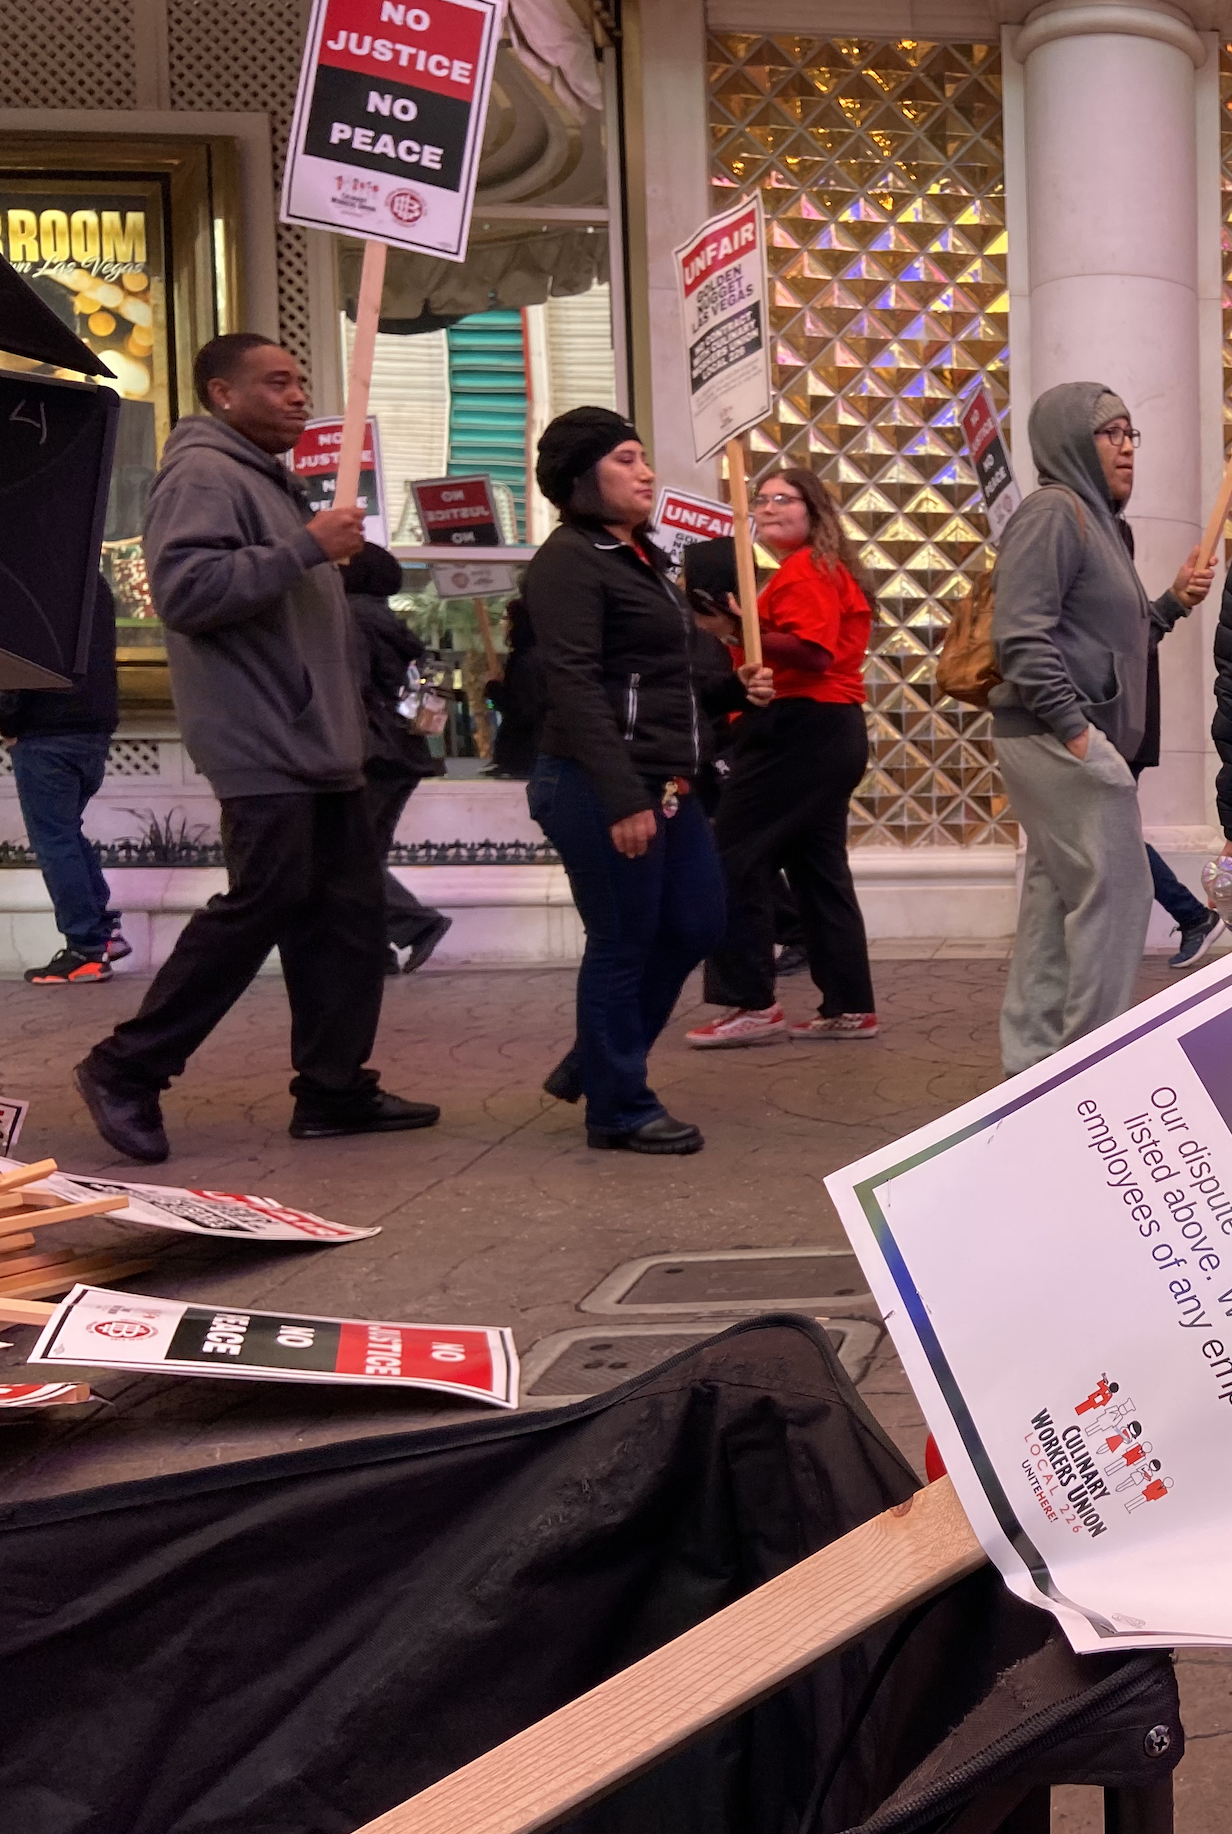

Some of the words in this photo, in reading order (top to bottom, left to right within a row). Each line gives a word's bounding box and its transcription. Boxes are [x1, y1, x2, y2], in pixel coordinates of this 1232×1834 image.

[380, 0, 431, 31] NO
[326, 30, 474, 84] JUSTICE
[366, 90, 419, 122] NO
[329, 121, 445, 170] PEACE
[7, 208, 147, 263] ROOM
[684, 222, 755, 285] UNFAIR
[32, 255, 77, 278] Las
[80, 256, 144, 282] Vegas
[696, 263, 742, 303] GOLDEN
[692, 311, 709, 335] LAS
[711, 284, 754, 316] VEGAS
[296, 450, 374, 469] JUSTE
[318, 434, 344, 446] NO
[1150, 1086, 1190, 1132] Our
[1077, 1099, 1161, 1238] employees
[1123, 1112, 1181, 1183] listed
[1163, 1188, 1221, 1281] above.
[1151, 1243, 1188, 1270] of
[1168, 1277, 1213, 1329] any
[276, 1324, 316, 1349] NO
[365, 1326, 402, 1376] JUSTICE
[431, 1341, 466, 1363] NO
[1024, 1432, 1060, 1497] LOCAL
[1059, 1503, 1083, 1534] 226
[1030, 1407, 1077, 1487] WORKERS
[1067, 1483, 1108, 1538] UNION
[1061, 1424, 1111, 1501] CULINARY
